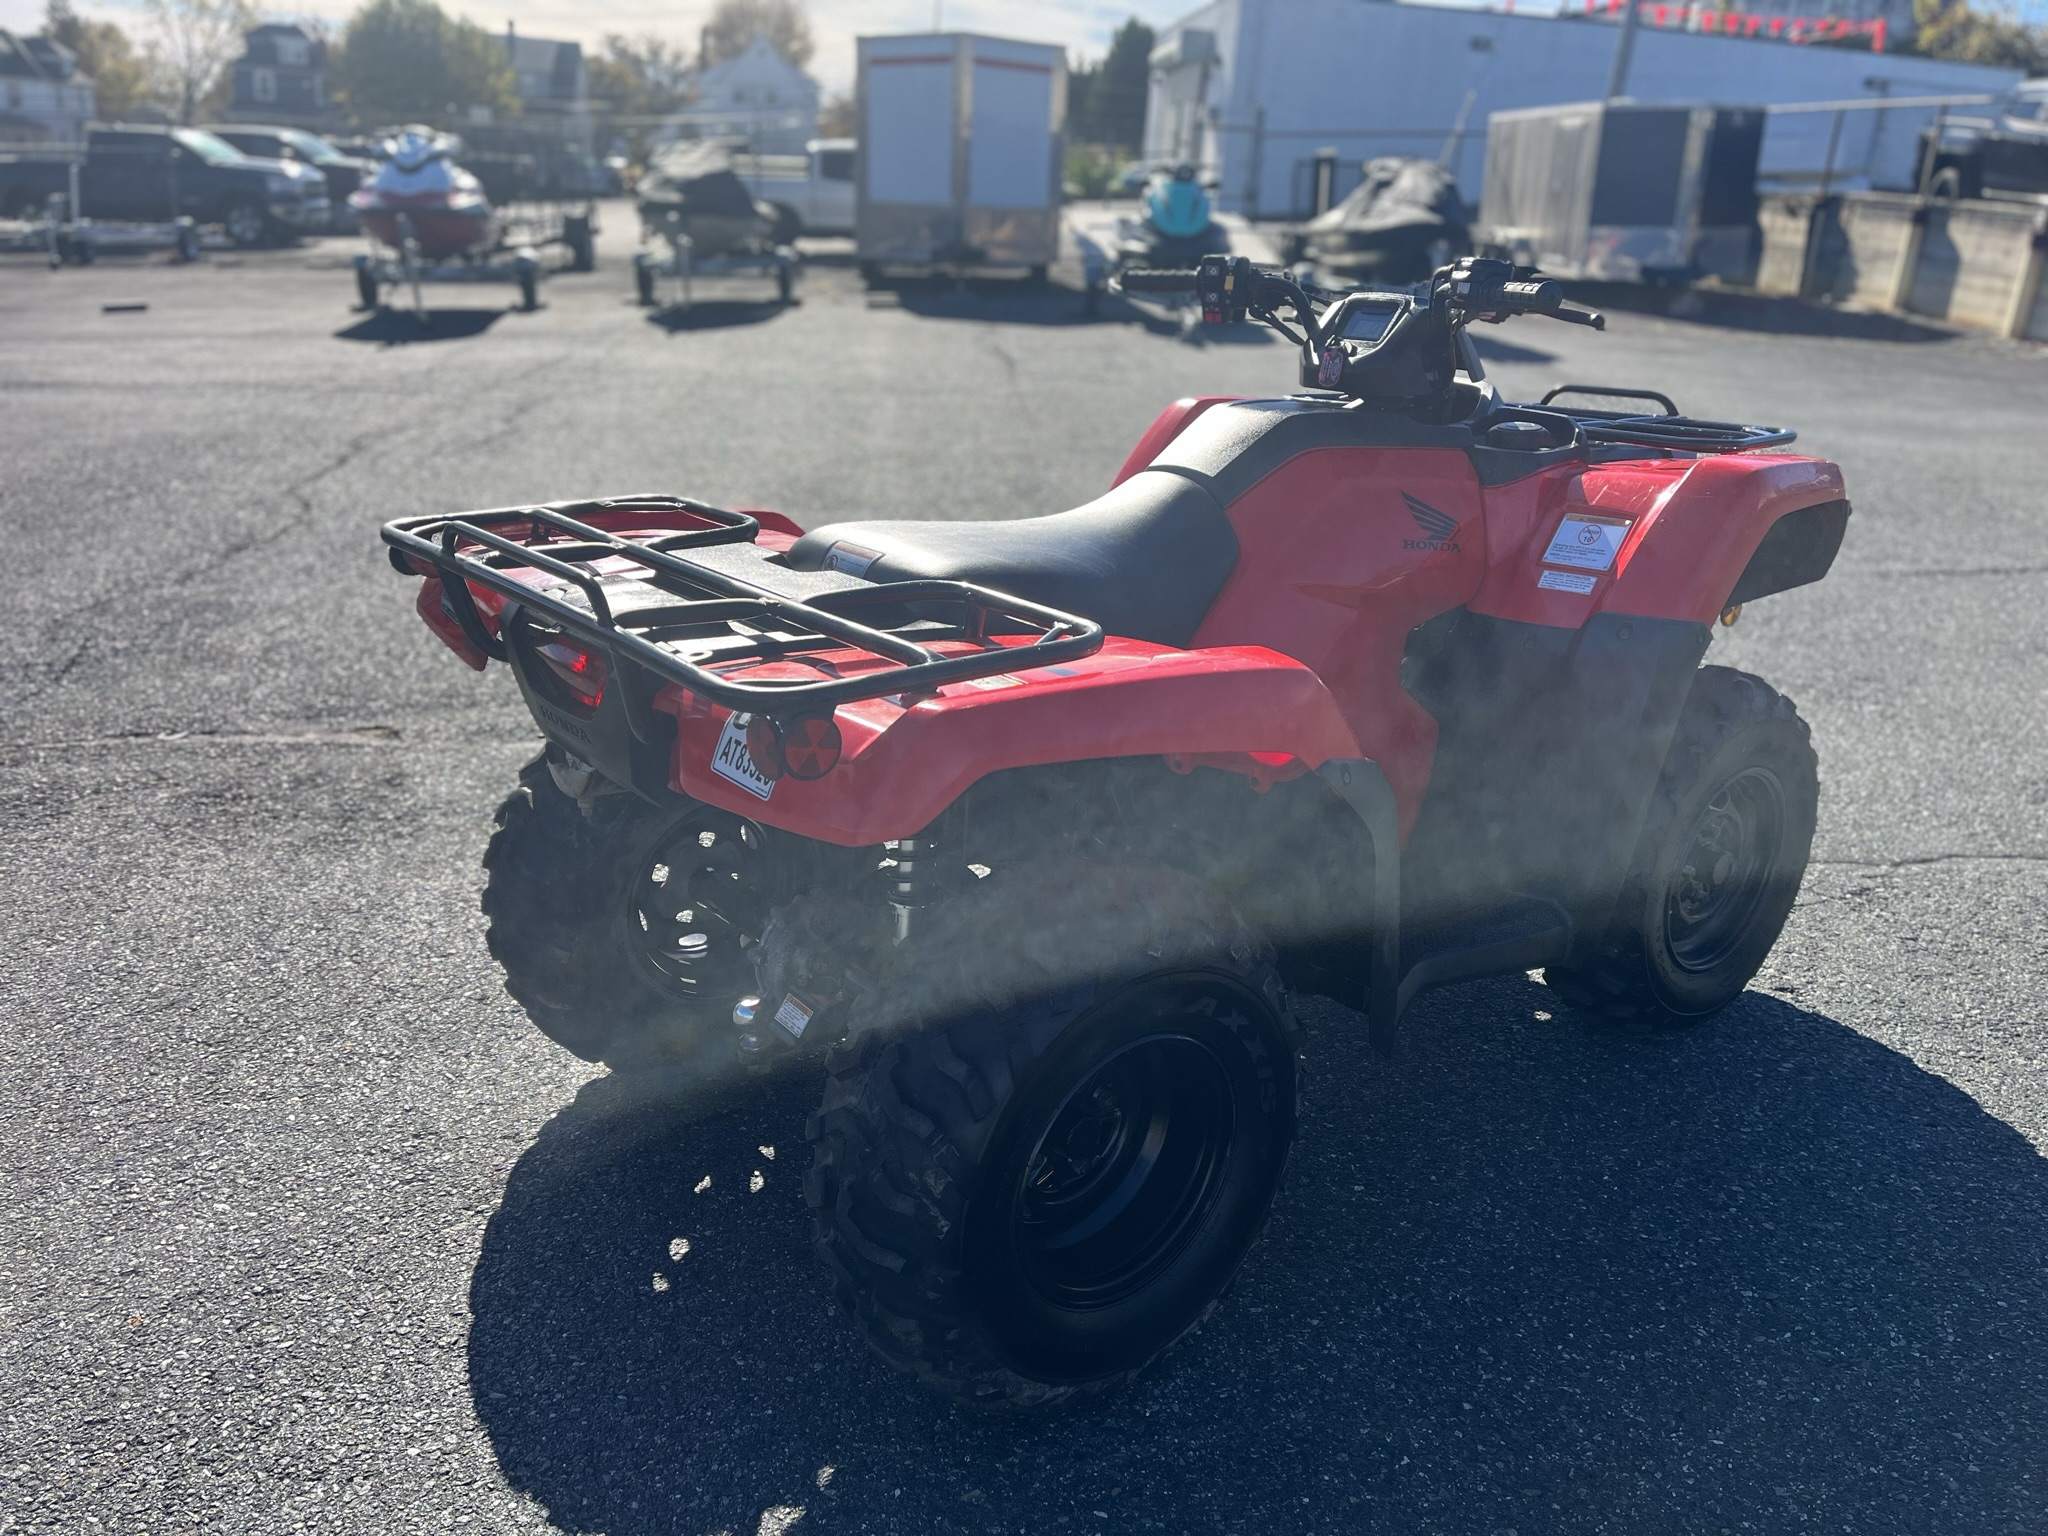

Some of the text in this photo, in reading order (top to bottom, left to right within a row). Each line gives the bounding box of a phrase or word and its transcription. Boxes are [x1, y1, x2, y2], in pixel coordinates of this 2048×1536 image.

[1403, 539, 1462, 553] HONDA
[540, 705, 592, 744] HONDA
[1155, 996, 1277, 1114] AXXIS
